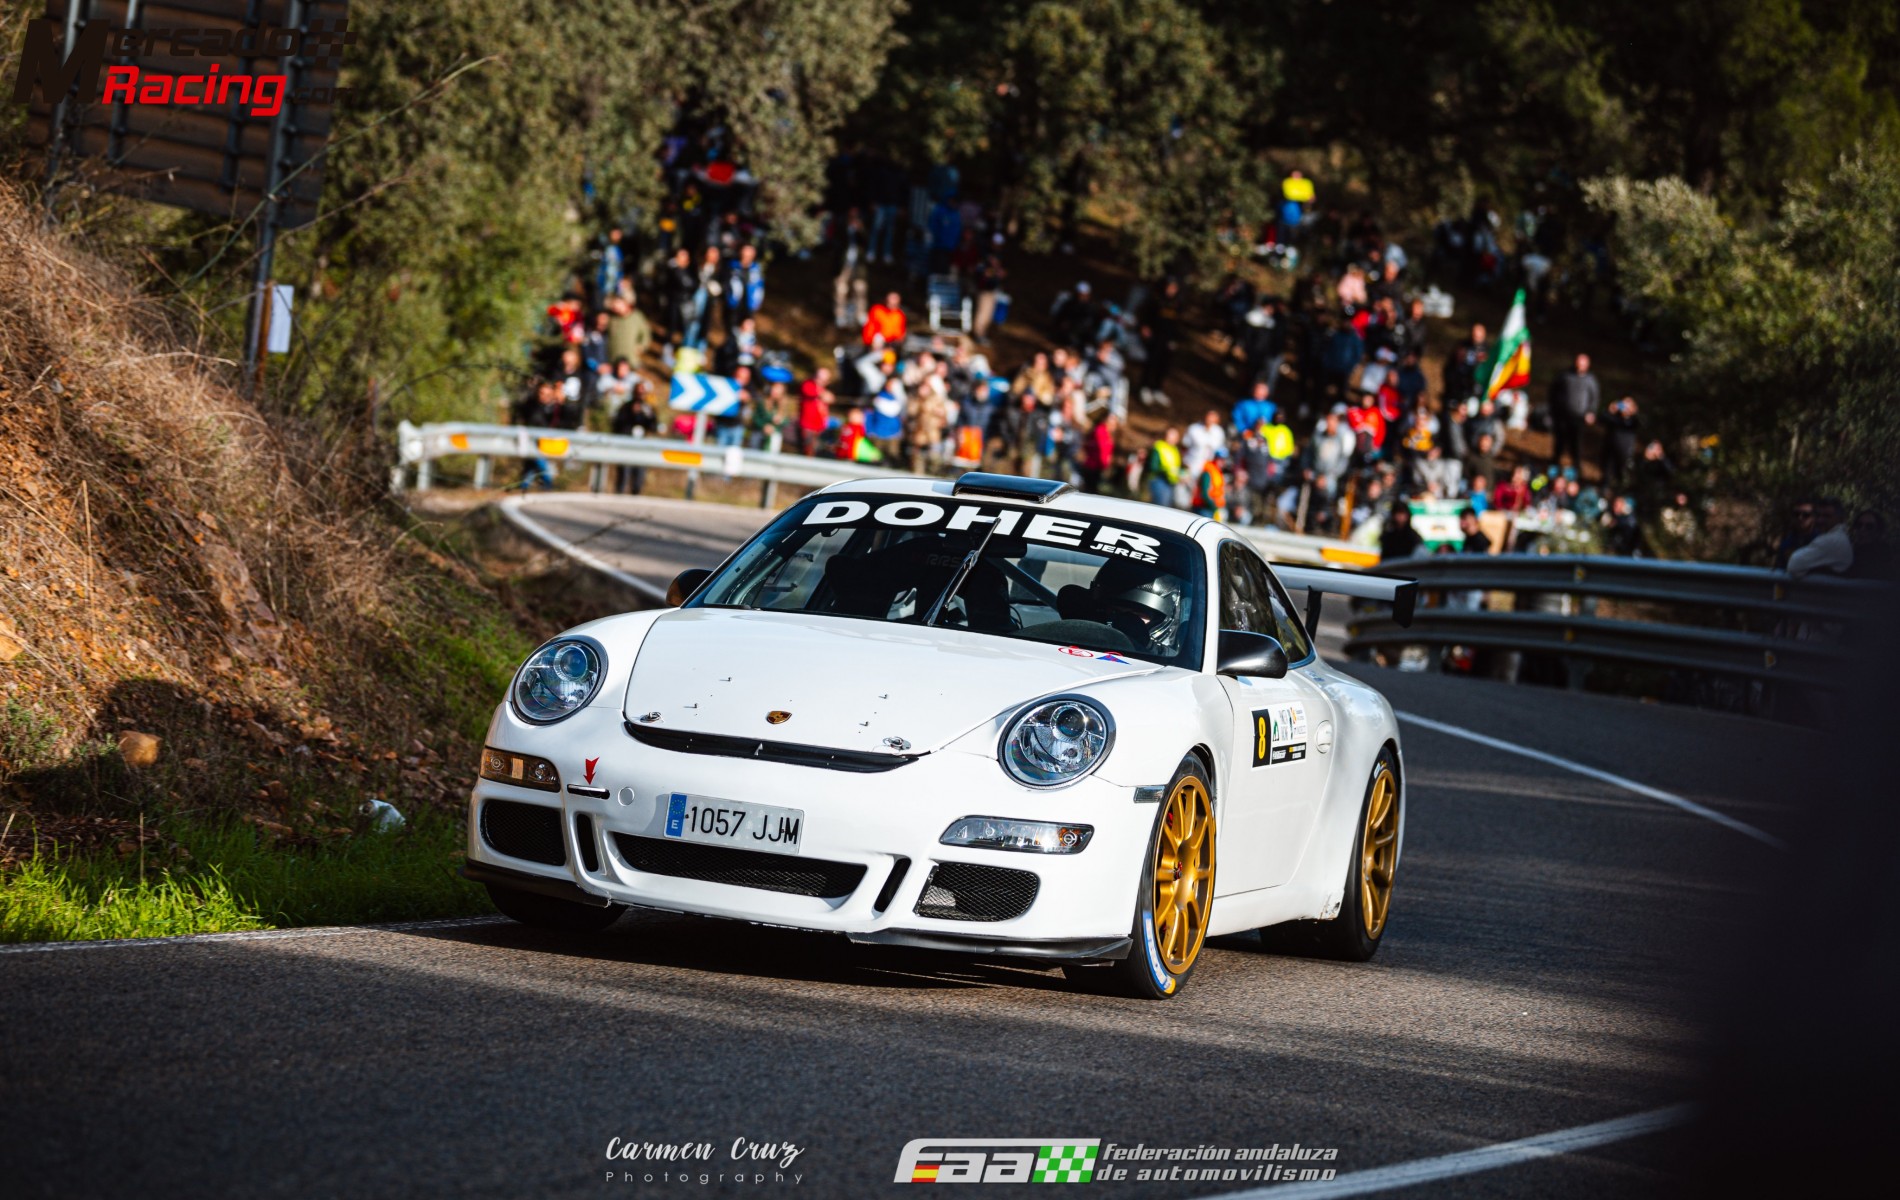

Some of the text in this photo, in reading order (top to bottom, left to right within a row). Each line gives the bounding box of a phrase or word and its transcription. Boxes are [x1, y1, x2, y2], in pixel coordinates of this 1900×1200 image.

[802, 500, 1161, 555] DOHER
[1090, 542, 1160, 564] JEREZ
[1258, 716, 1267, 760] 8
[671, 819, 679, 830] E
[691, 806, 801, 845] 1057 JJM
